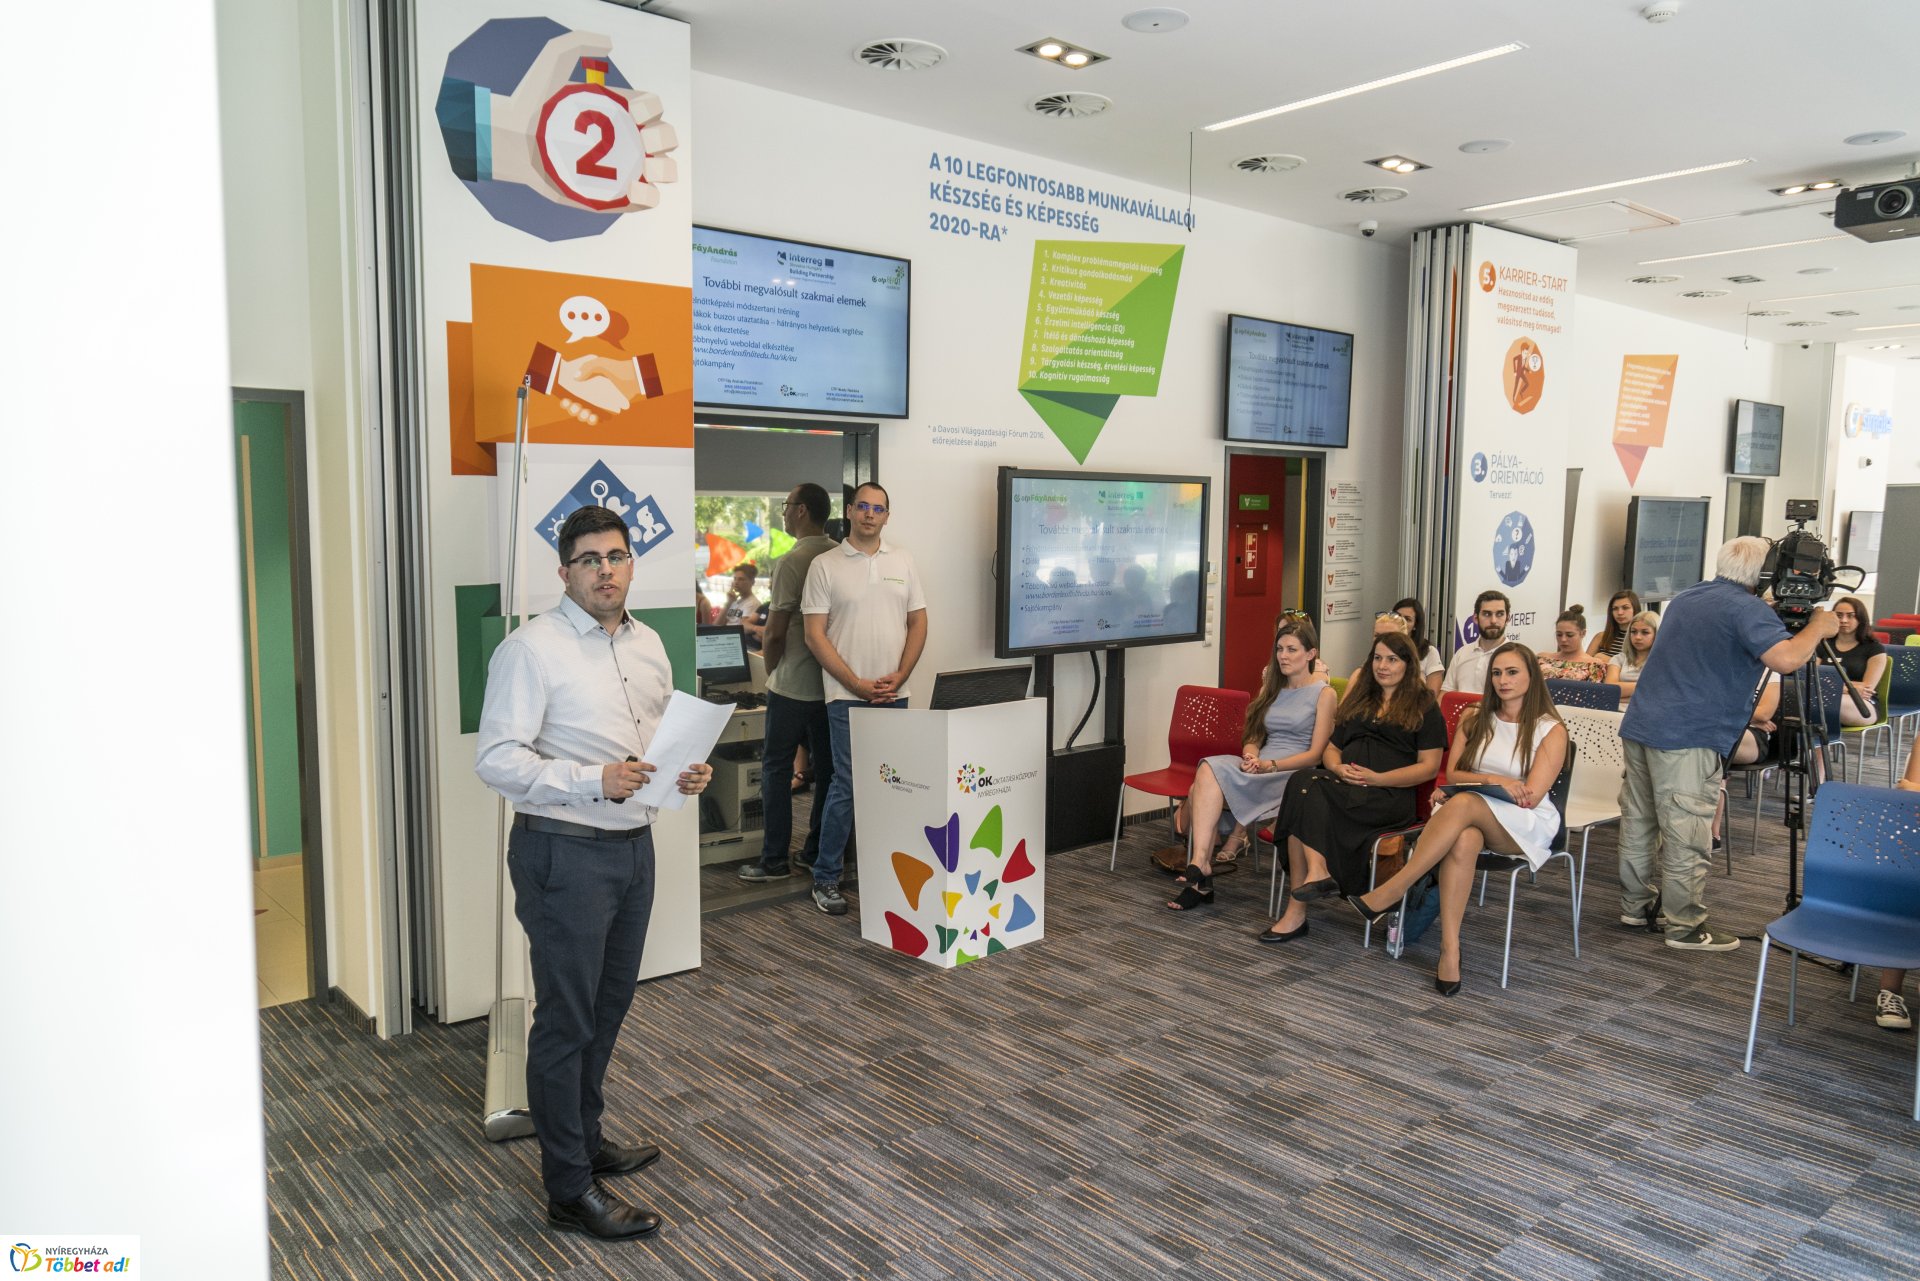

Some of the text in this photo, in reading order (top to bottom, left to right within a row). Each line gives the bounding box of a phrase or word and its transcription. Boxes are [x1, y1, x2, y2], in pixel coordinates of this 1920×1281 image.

[574, 109, 617, 181] 2
[929, 152, 1196, 229] A 10 LEGFONTOSABB MUNKAVÁLLALÓI
[930, 180, 1099, 233] KÉSZSÉG ÉS KÉPESSÉG
[1052, 251, 1081, 263] Komplex
[1051, 264, 1078, 275] Kritikus
[1050, 277, 1087, 290] Kreativitás
[1483, 266, 1568, 293] 5. KARRIER-START
[703, 276, 867, 308] További megvalósult szakmai elemek
[736, 302, 776, 314] módszertani
[777, 307, 800, 318] tréning
[713, 311, 735, 322] buszos
[776, 318, 808, 331] hátrányos
[1523, 320, 1535, 332] meg
[713, 325, 750, 335] étkeztetése
[730, 339, 761, 349] weboldal
[1104, 361, 1129, 372] érvelési
[1039, 370, 1068, 382] Kognitív
[1068, 373, 1110, 385] rugalmasság
[937, 425, 960, 435] Davosi
[960, 426, 1008, 439] Világgazdasági
[1008, 428, 1029, 438] Fórum
[973, 439, 997, 449] alapján
[1474, 450, 1523, 475] 3. PÁLYA-
[1490, 467, 1544, 485] ORIENTÁCIÓ
[1467, 622, 1477, 638] 1.
[891, 775, 901, 784] OK
[978, 775, 993, 788] OK
[1016, 770, 1039, 782] KÖZPONT
[977, 785, 1012, 799] NYÍREGYHÁZA
